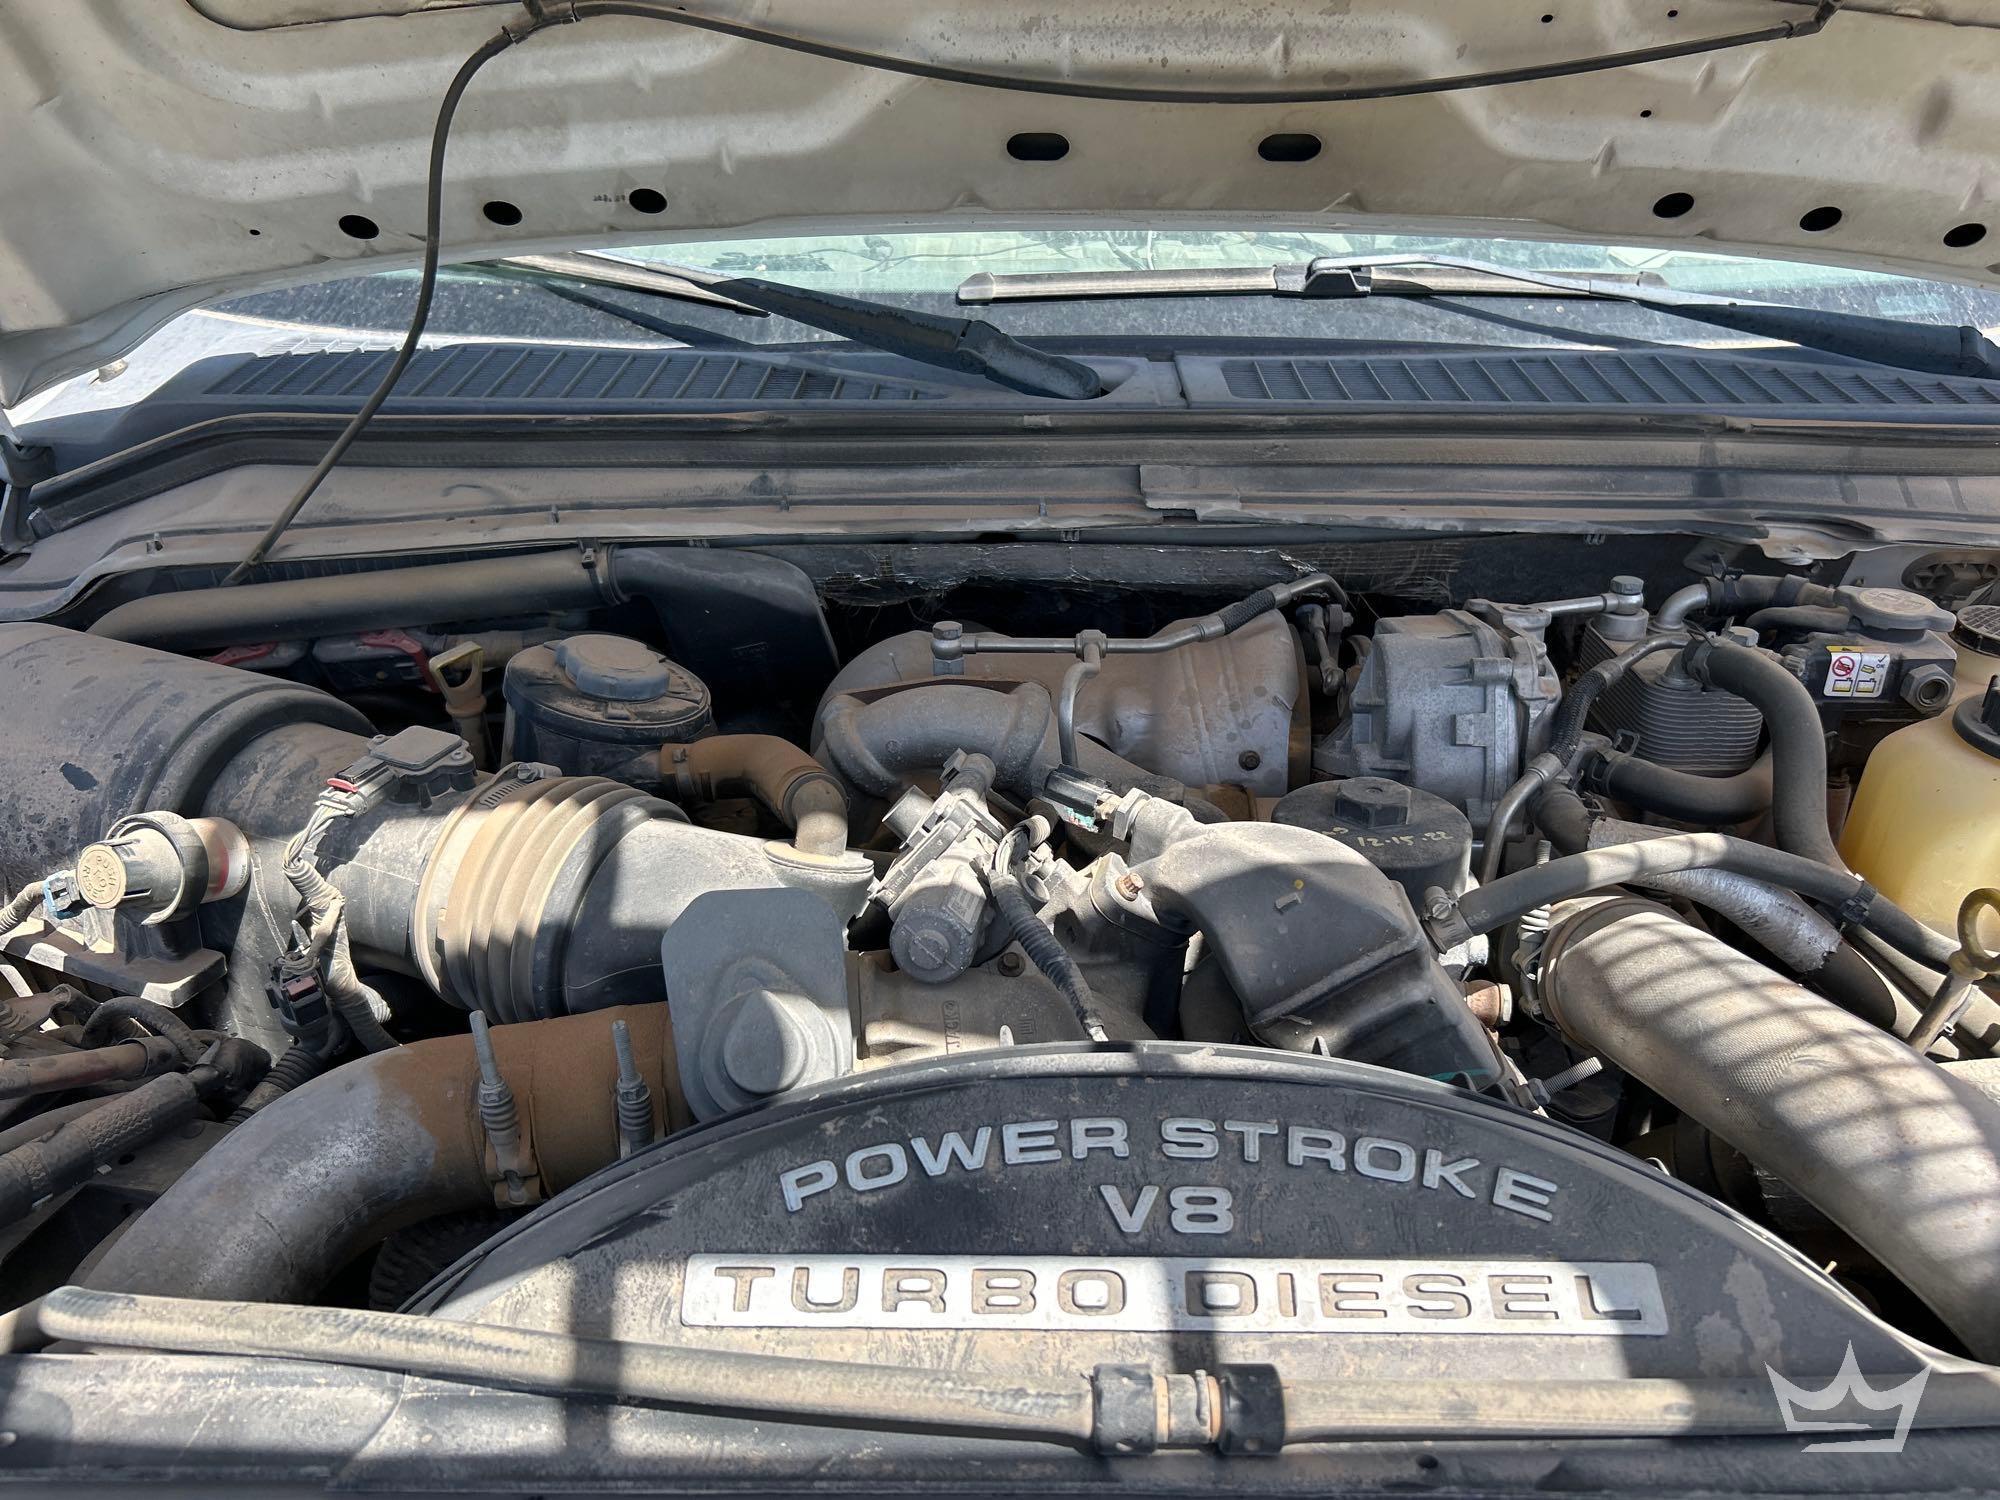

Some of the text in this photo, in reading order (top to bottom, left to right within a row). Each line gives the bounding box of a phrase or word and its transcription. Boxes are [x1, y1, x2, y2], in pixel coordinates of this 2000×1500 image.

[780, 1117, 1558, 1222] POWER STROKE
[1100, 1185, 1234, 1234] V8
[714, 1266, 1642, 1320] TURBO DIESEL
